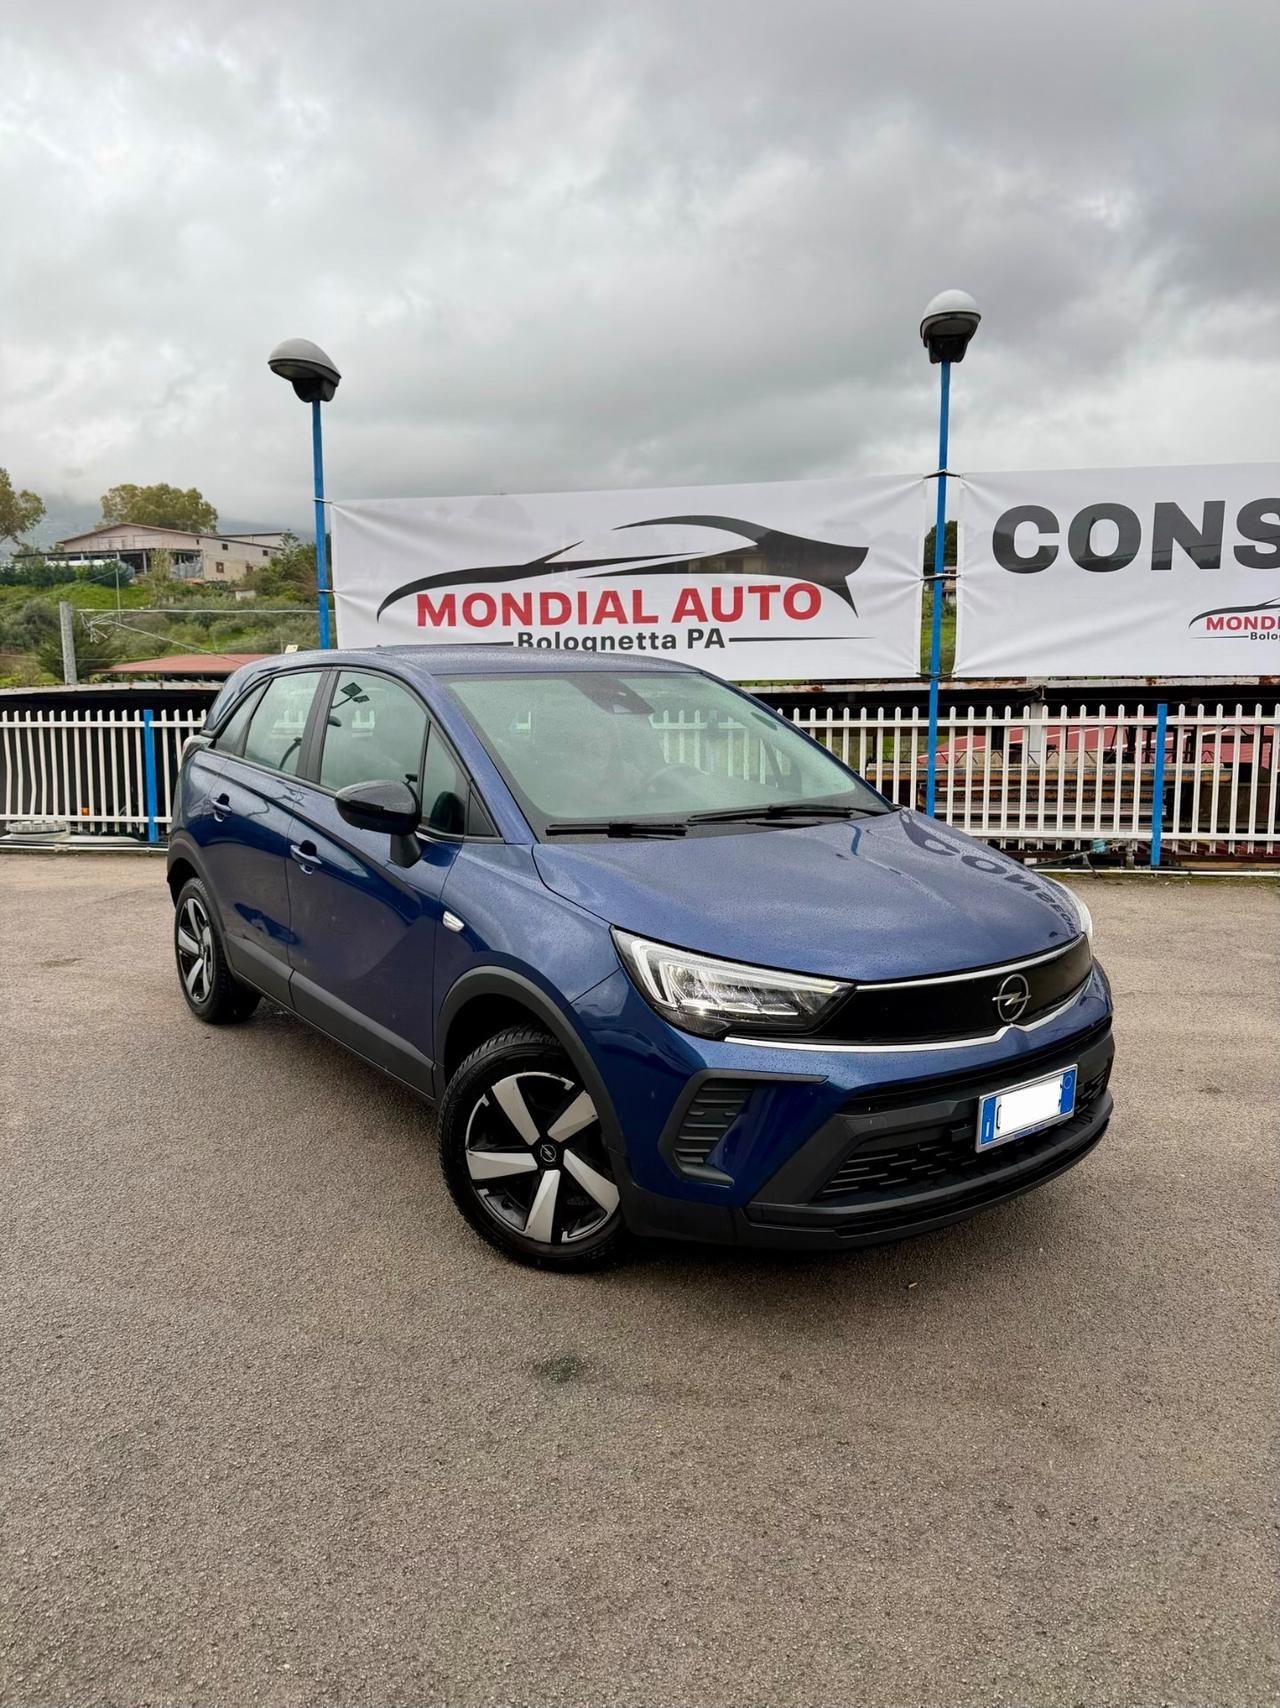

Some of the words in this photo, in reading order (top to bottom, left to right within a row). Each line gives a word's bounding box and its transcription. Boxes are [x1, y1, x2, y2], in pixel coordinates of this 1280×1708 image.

[992, 498, 1280, 574] CONS
[416, 589, 658, 628] MONDIAL
[671, 582, 822, 624] AUTO
[687, 627, 726, 650] PA
[1249, 631, 1280, 641] Bolo
